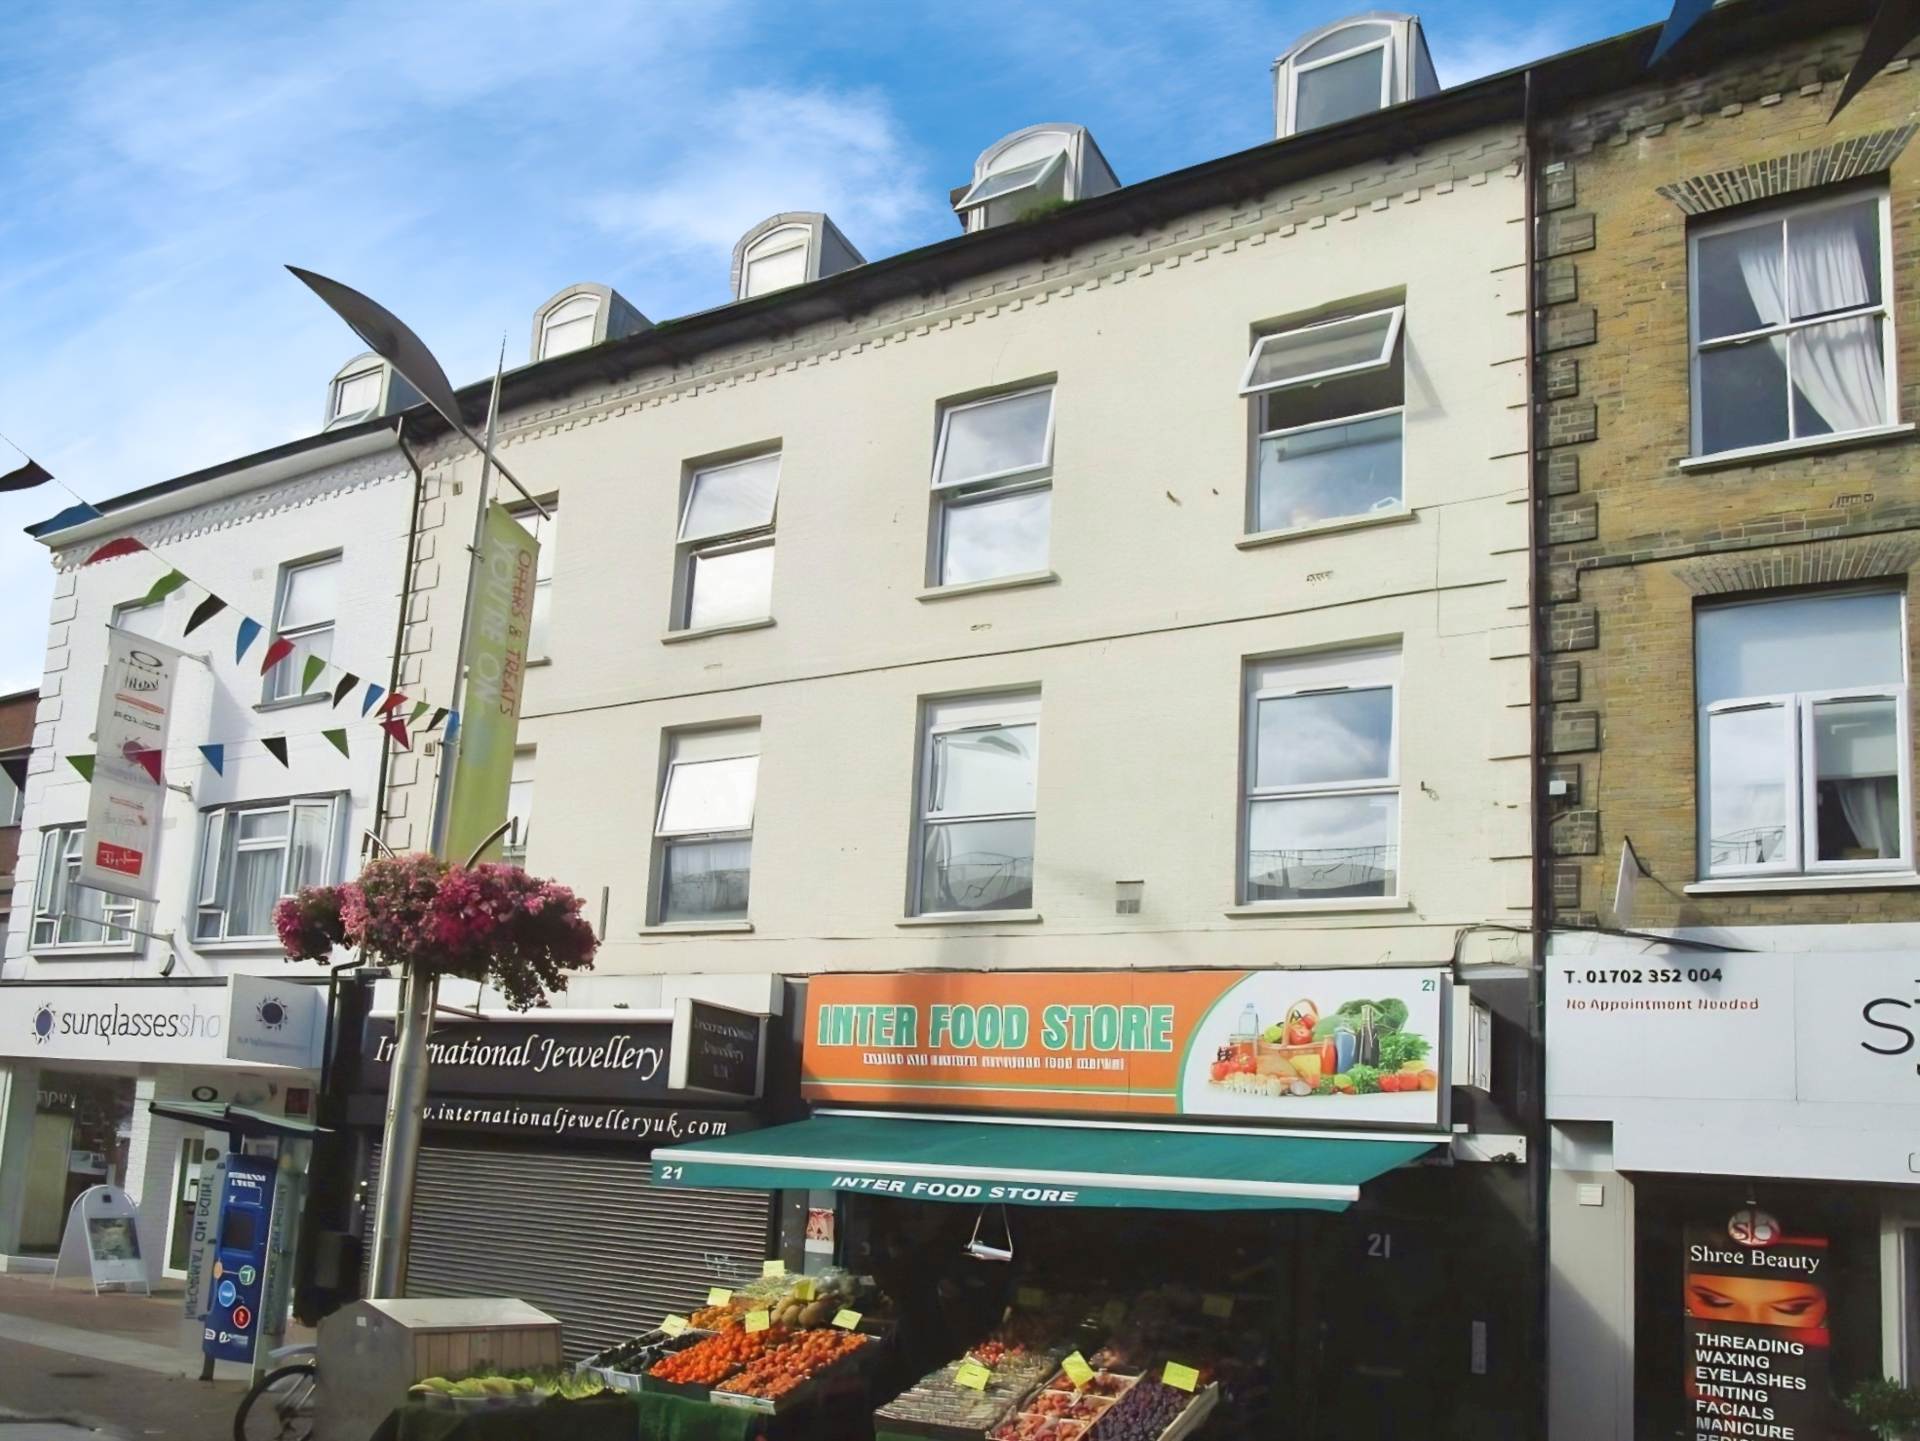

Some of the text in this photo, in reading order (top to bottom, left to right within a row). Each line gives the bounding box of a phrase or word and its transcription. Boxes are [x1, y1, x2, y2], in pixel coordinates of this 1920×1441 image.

[499, 650, 521, 718] TREATS
[1421, 979, 1436, 992] 21
[1563, 968, 1723, 984] T. 01702 352 004
[1566, 997, 1760, 1012] No Appointment Needed
[816, 1003, 1176, 1053] INTER FOOD STORE
[533, 1035, 664, 1081] Jewellery
[661, 1166, 683, 1181] 21
[832, 1176, 1079, 1203] INTER FOOD STORE
[1368, 1233, 1391, 1259] 21
[1690, 1244, 1820, 1274] Shree Beauty
[1695, 1332, 1805, 1356] THREADING
[1695, 1348, 1770, 1369] WAXING
[1695, 1366, 1807, 1391] EYELASHES
[1695, 1382, 1768, 1403] TINTING
[1696, 1399, 1775, 1421] FACIALS
[1696, 1416, 1795, 1441] MANICURE
